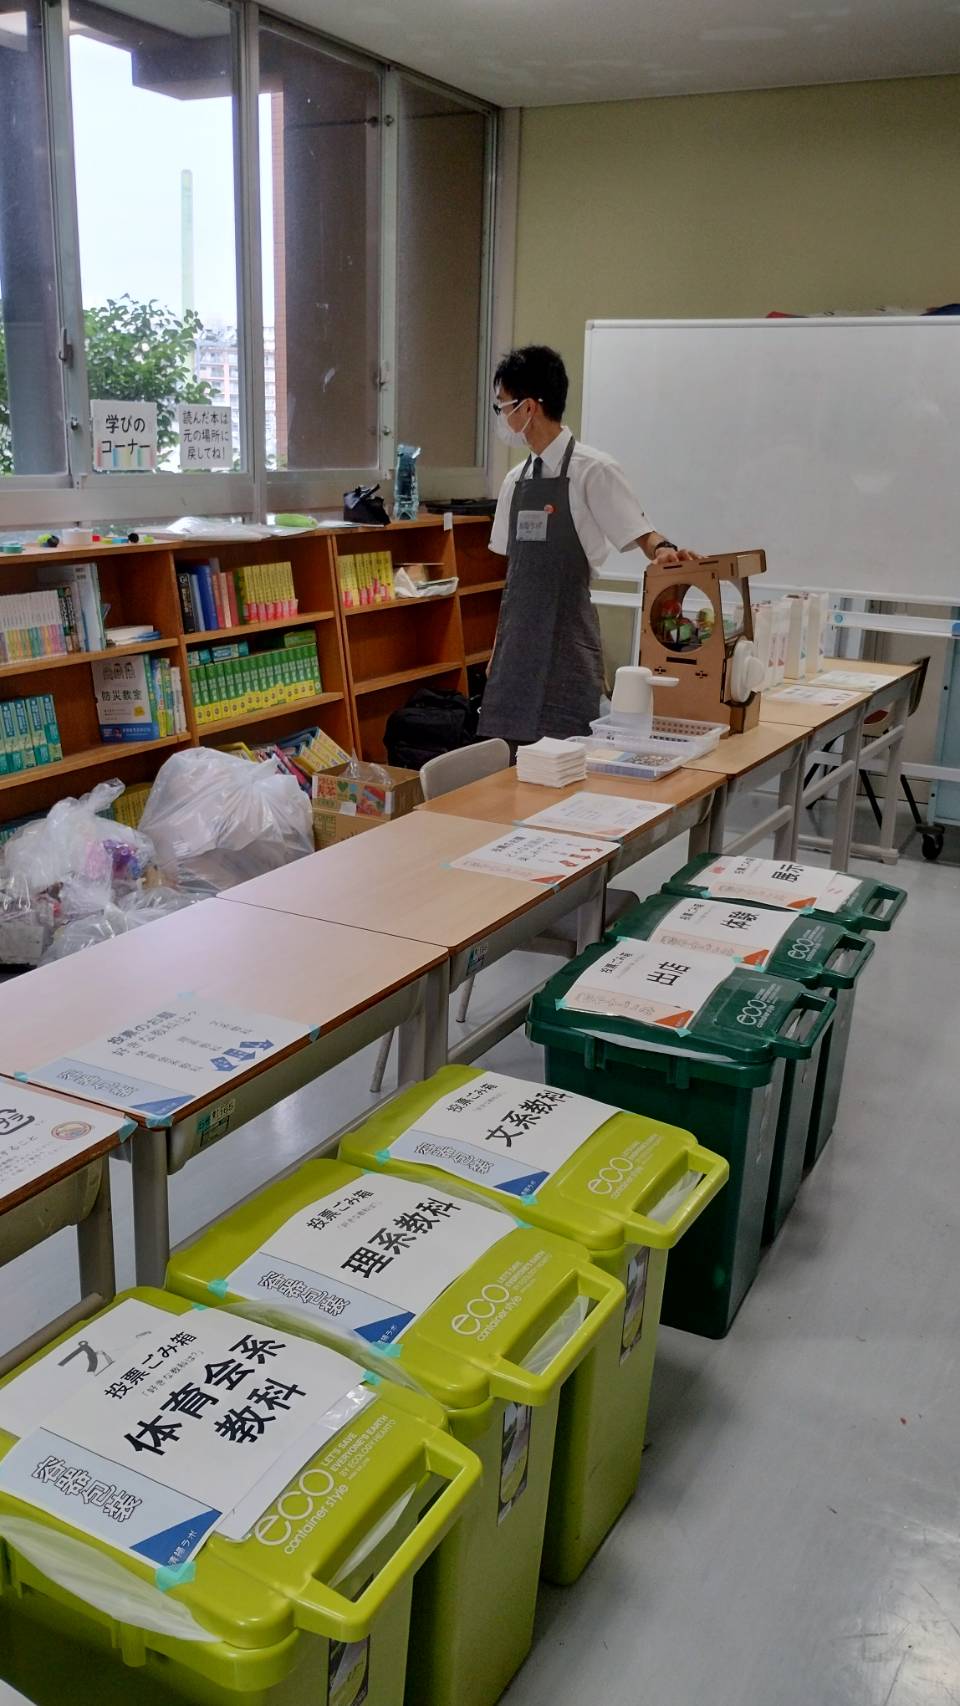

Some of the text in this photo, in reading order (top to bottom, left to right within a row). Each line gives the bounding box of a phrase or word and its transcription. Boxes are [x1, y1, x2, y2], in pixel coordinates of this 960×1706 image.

[105, 414, 146, 434] 学びの
[183, 411, 229, 425] 読んだ本は
[183, 429, 229, 443] 元の場所に
[101, 438, 151, 456] コーナー
[770, 863, 805, 884] 展示
[719, 910, 760, 931] 体験
[787, 937, 814, 960] eco
[646, 960, 692, 987] 出店
[736, 999, 767, 1026] eco
[446, 1082, 499, 1113] 投票ごみ箱
[484, 1089, 575, 1148] 文系教科
[587, 1156, 634, 1195] eco
[305, 1188, 377, 1232] 投票ごみ箱
[341, 1197, 464, 1280] 理系教科
[256, 1269, 352, 1317] 容器包装
[451, 1283, 510, 1336] eco
[103, 1330, 198, 1400] 投票ごみ箱
[123, 1334, 287, 1457] 体育会系
[213, 1377, 308, 1445] 教科
[31, 1454, 144, 1523] 容器包装
[254, 1468, 334, 1546] eco
[284, 1484, 348, 1554] container style
